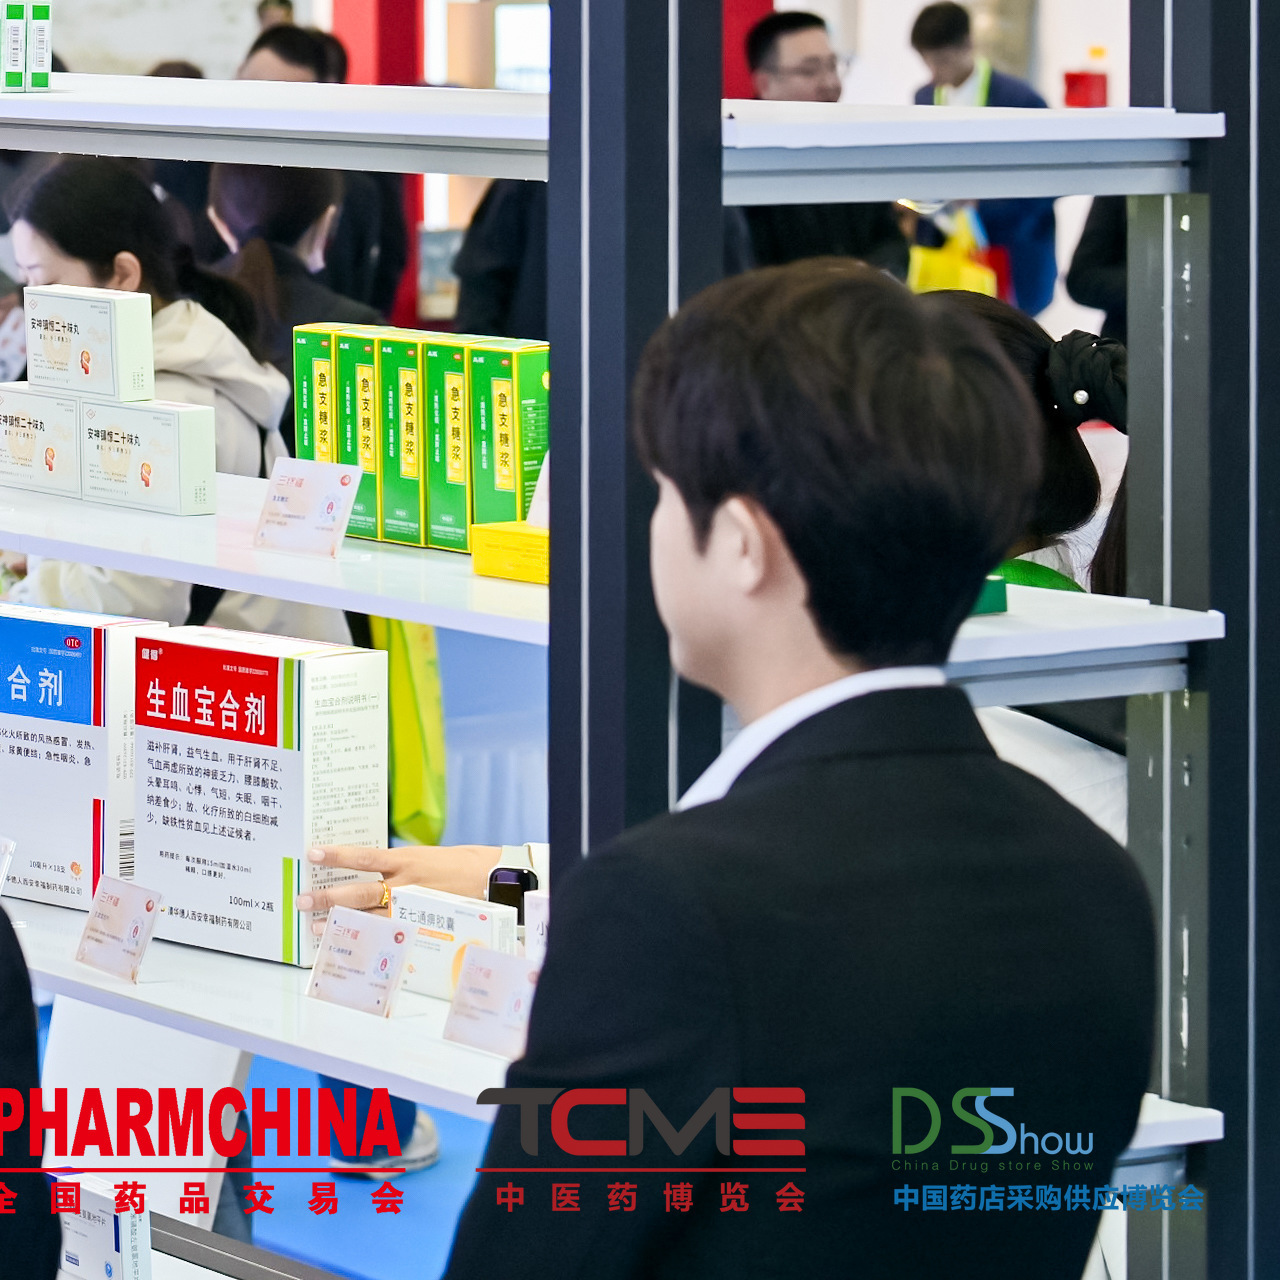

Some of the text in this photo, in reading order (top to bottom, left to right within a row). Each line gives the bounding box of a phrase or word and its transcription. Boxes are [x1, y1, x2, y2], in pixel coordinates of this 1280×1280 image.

[318, 372, 328, 444] 急支糖浆
[361, 378, 371, 450] 急支糖浆
[404, 382, 414, 455] 急支糖浆
[451, 386, 461, 461] 急支糖浆
[498, 392, 510, 467] 急支糖浆
[66, 639, 79, 648] OTC
[146, 677, 266, 736] 生血宝合剂
[6, 875, 83, 896] 华德人西安幸福制药有限公司
[398, 906, 456, 932] 玄七通痹胶囊
